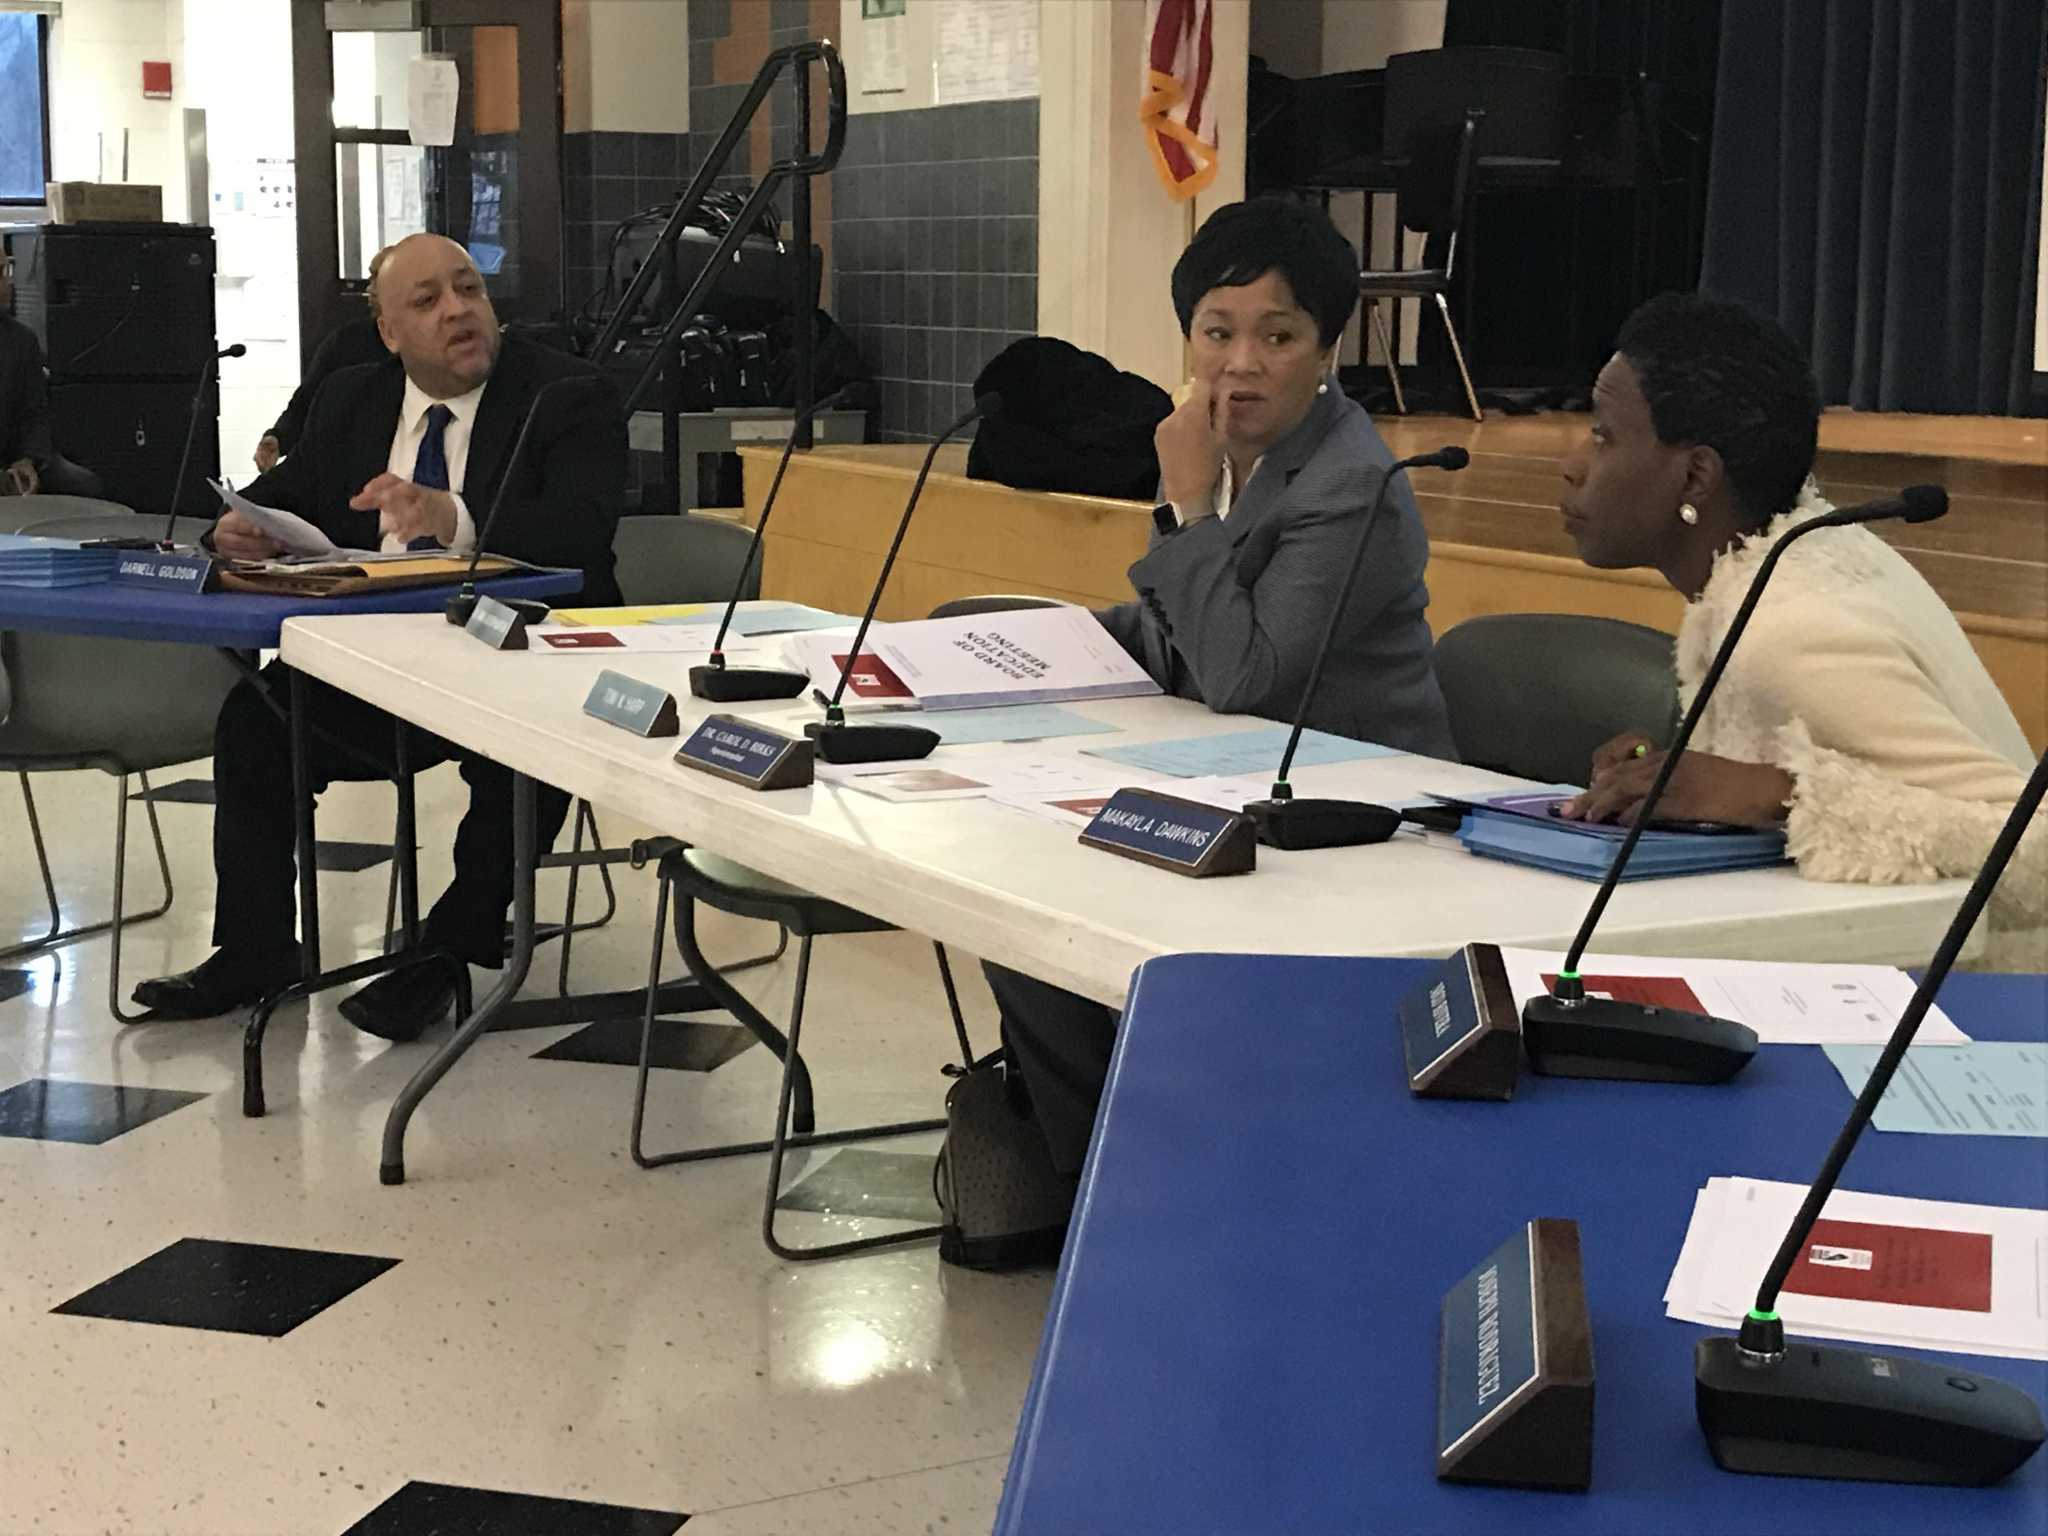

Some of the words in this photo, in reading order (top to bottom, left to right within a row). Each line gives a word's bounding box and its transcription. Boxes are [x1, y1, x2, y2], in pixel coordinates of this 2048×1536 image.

[120, 561, 156, 577] DARNELL
[952, 640, 975, 651] OF
[963, 632, 1045, 678] EDUCATION
[987, 632, 1052, 669] MEETING
[974, 651, 1025, 679] BOARD
[1099, 807, 1155, 833] MAKAYLA
[1154, 821, 1211, 847] DAWKINS
